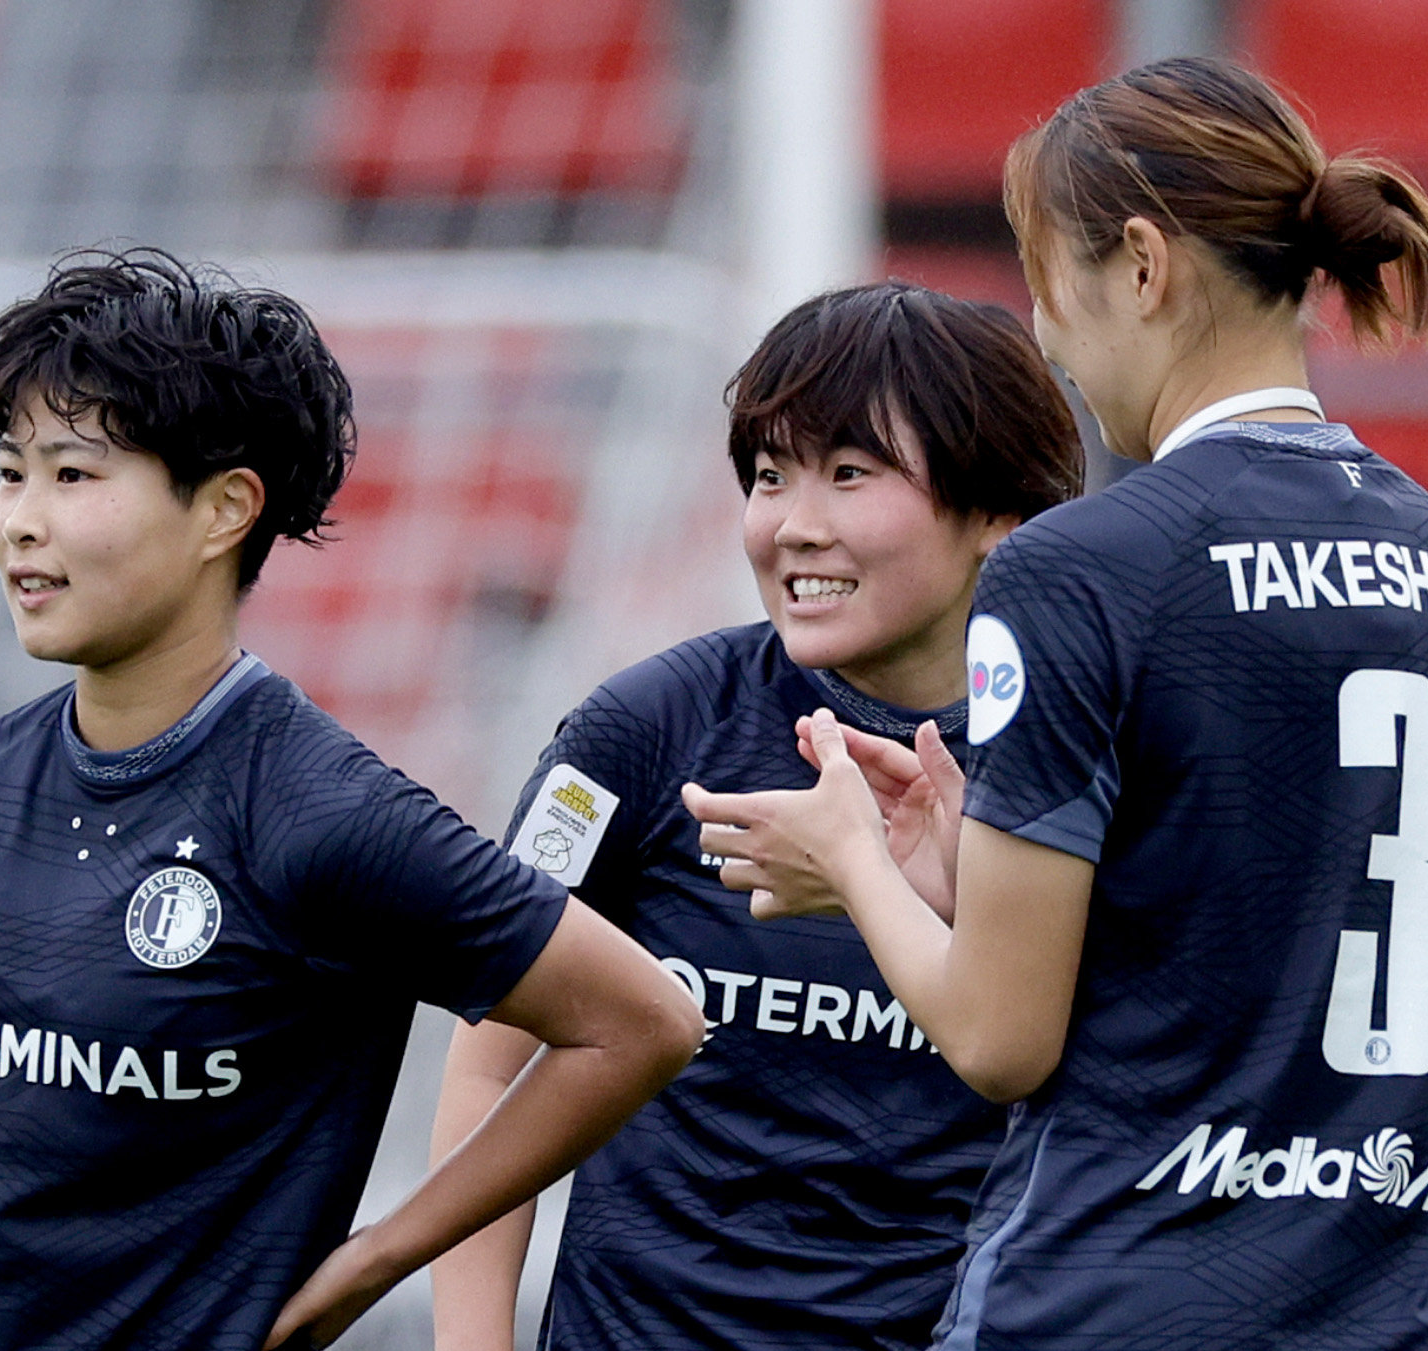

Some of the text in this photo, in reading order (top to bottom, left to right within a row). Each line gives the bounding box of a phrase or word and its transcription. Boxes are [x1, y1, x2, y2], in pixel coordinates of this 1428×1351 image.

[1338, 461, 1362, 488] F
[139, 872, 216, 910] FEYENOORD
[150, 893, 195, 940] F
[131, 927, 207, 964] ROTTERDAM
[1135, 1123, 1356, 1199] Media
